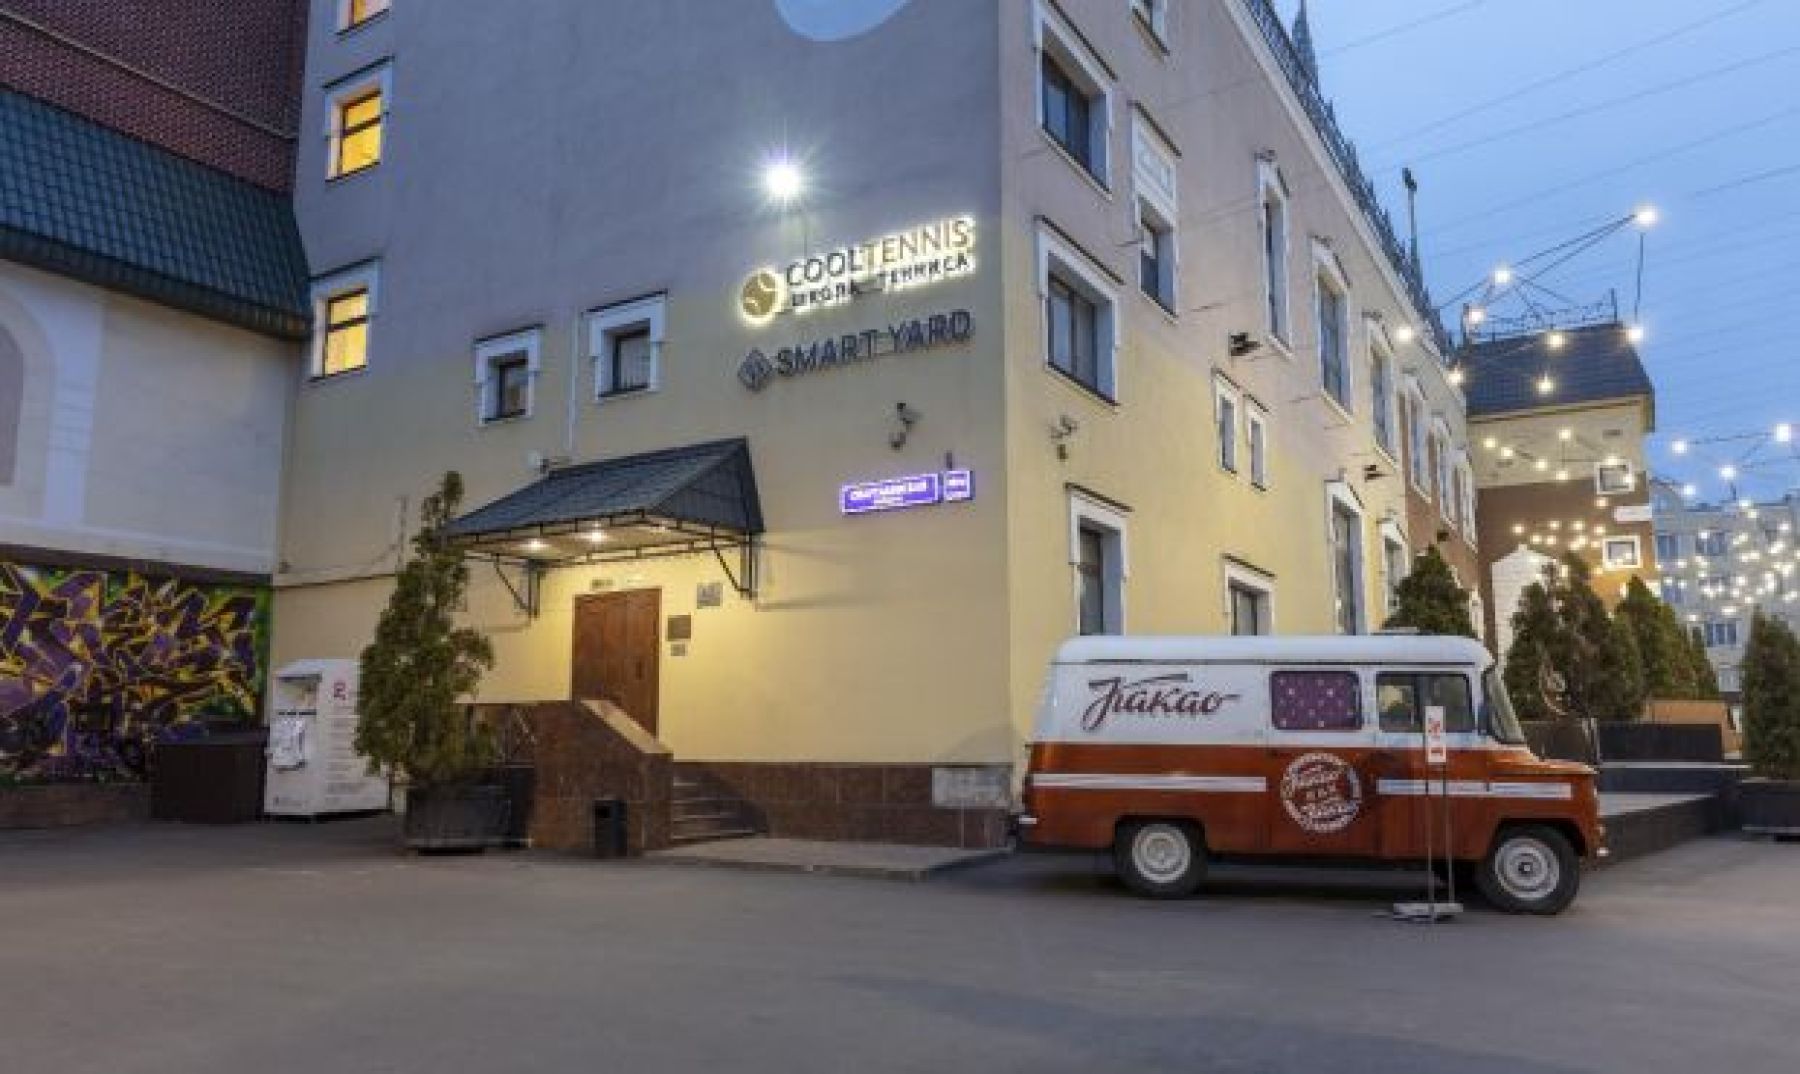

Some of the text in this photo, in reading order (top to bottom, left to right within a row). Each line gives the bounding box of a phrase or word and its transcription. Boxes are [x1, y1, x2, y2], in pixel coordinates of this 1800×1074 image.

[785, 218, 969, 287] COOLTENNIS
[776, 308, 972, 377] SMART YARD
